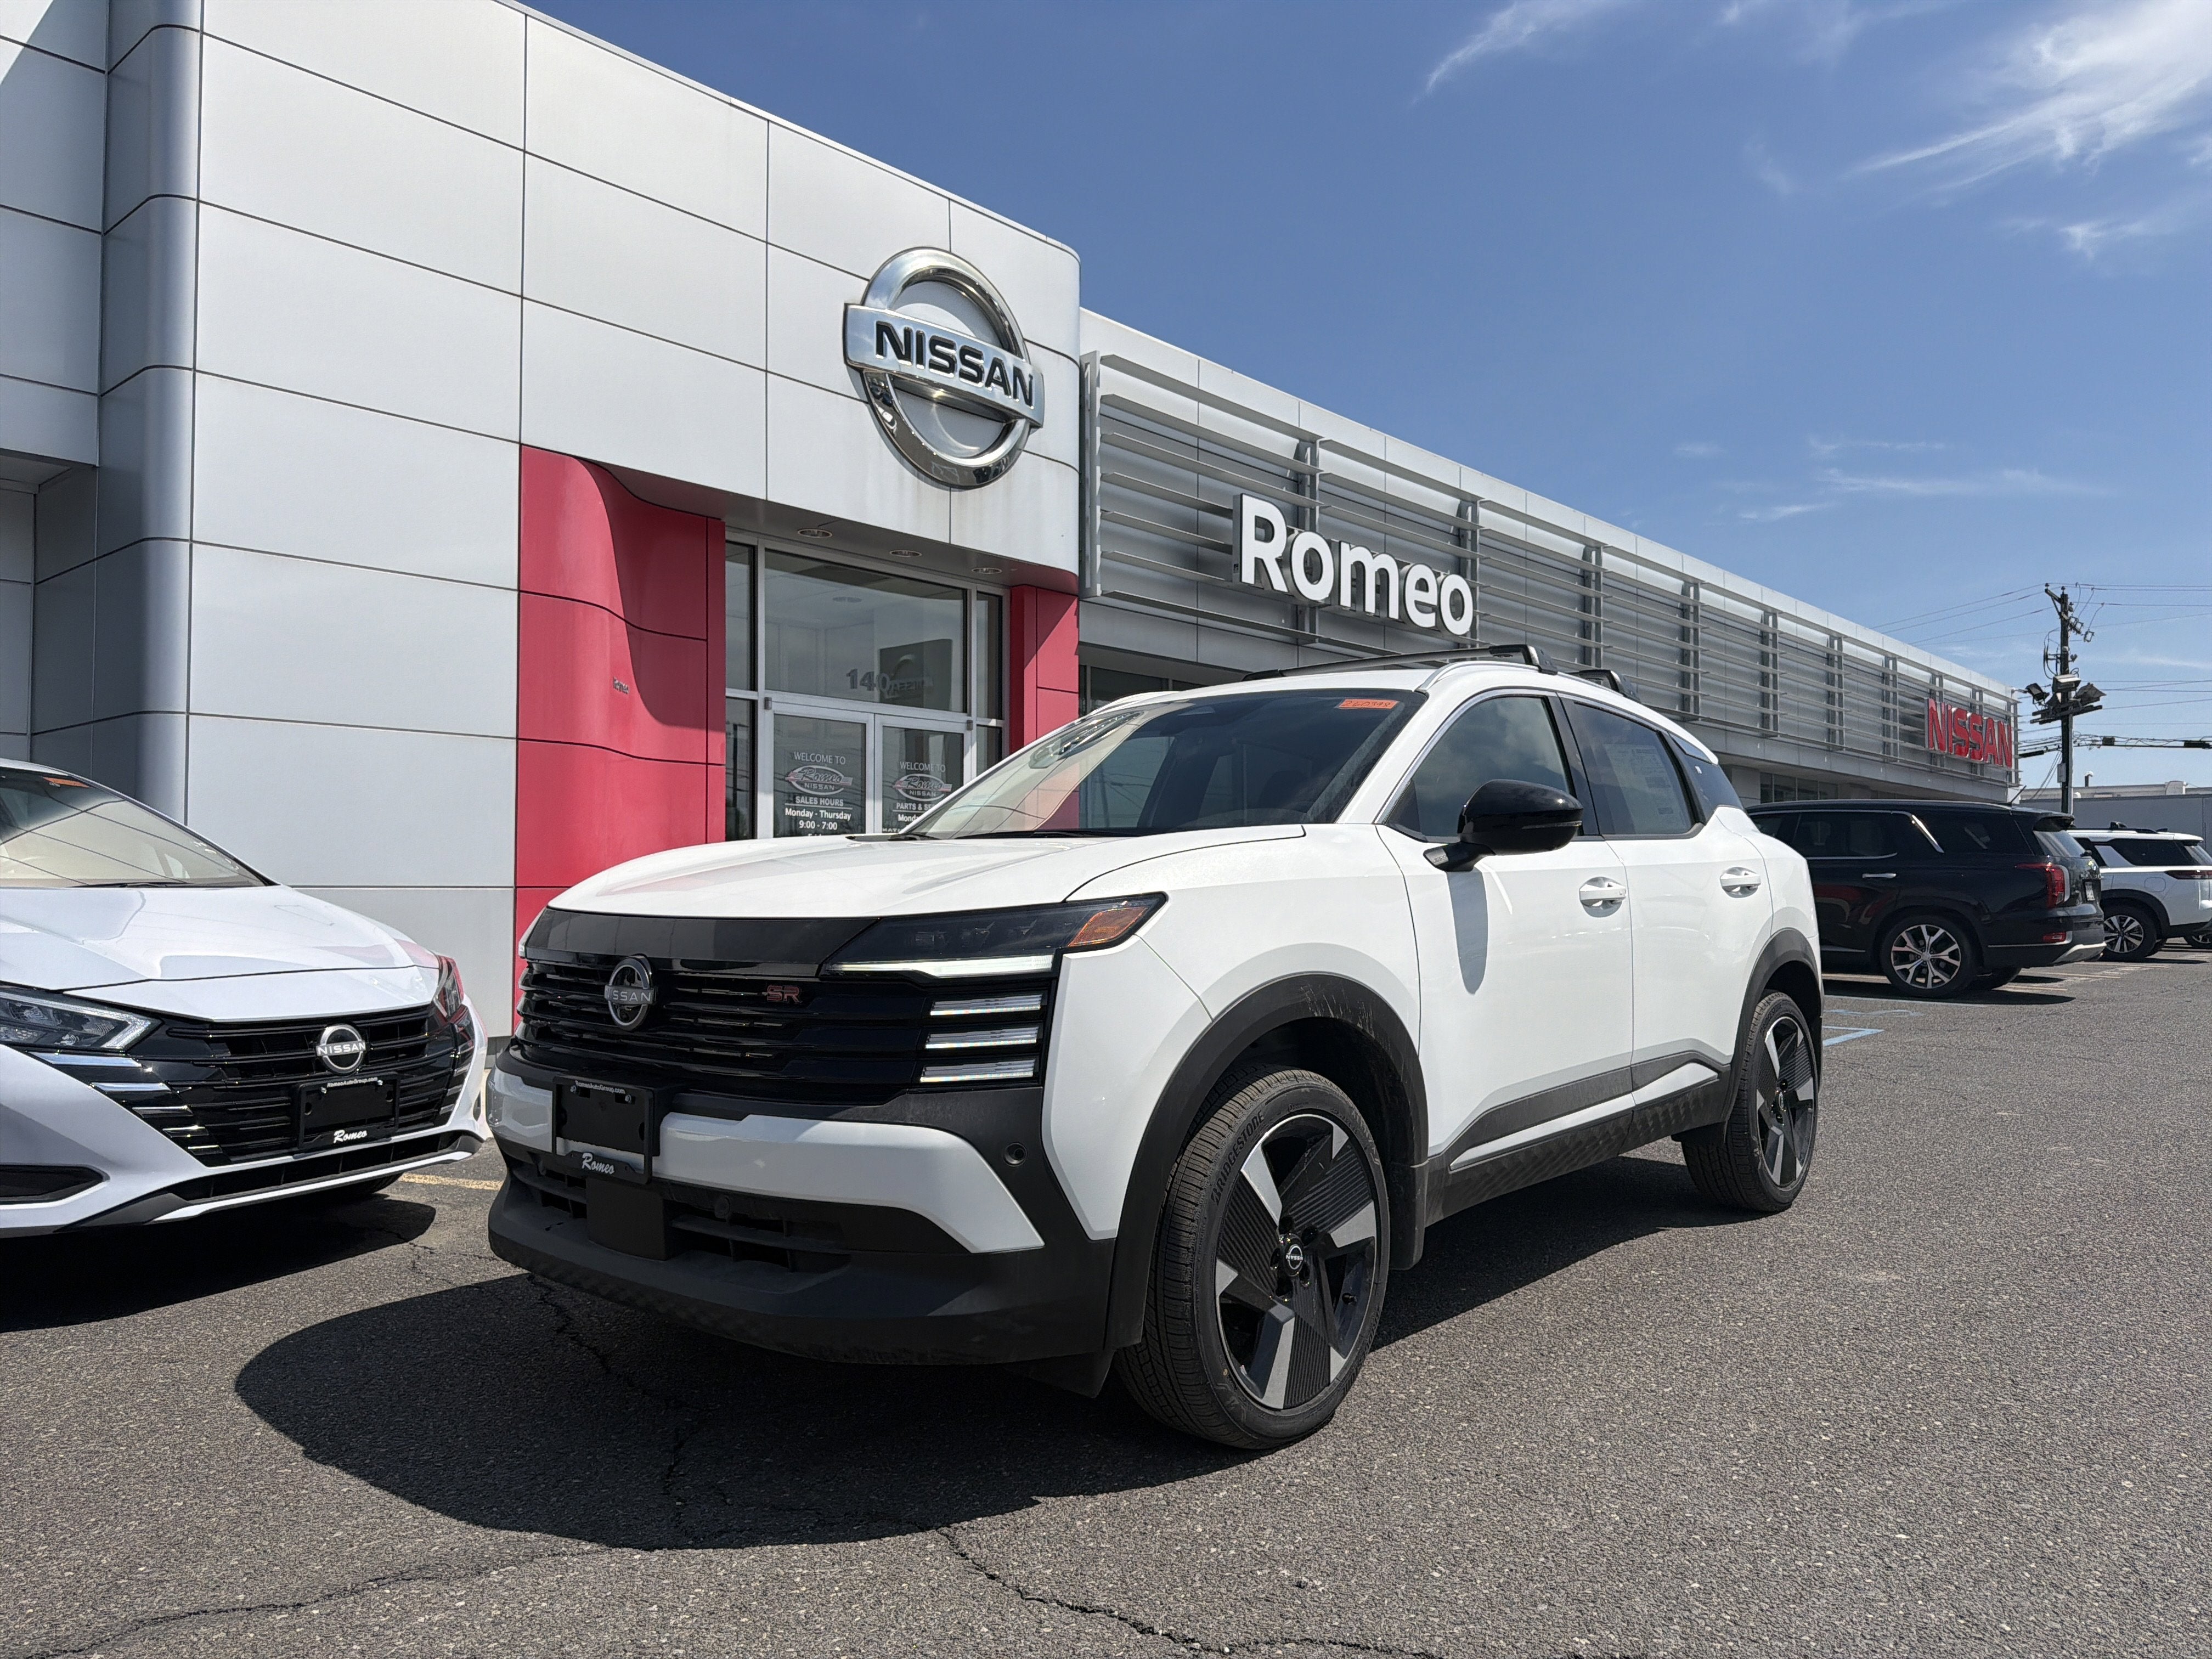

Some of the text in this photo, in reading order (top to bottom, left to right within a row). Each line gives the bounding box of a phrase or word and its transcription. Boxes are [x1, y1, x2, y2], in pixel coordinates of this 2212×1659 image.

[875, 320, 1034, 409] NISSAN
[1239, 493, 1474, 636] Romeo
[1927, 698, 2012, 768] NISSAN
[794, 752, 846, 765] WELCOME TO
[900, 761, 934, 771] WELCOME
[798, 767, 843, 783] Romeo
[904, 776, 943, 790] Romeo
[795, 796, 844, 806] SALES HOURS
[785, 808, 814, 819] Monday
[820, 810, 851, 821] Thursday
[799, 820, 815, 829] 9:00
[822, 821, 838, 830] 7:00
[767, 985, 800, 1005] SR
[318, 1042, 366, 1056] NISSAN
[327, 1077, 378, 1087] RomeoAutoGroup.com
[334, 1130, 368, 1144] Romeo
[582, 1153, 615, 1175] Romeo
[1210, 1109, 1265, 1206] BRIDGESTONE
